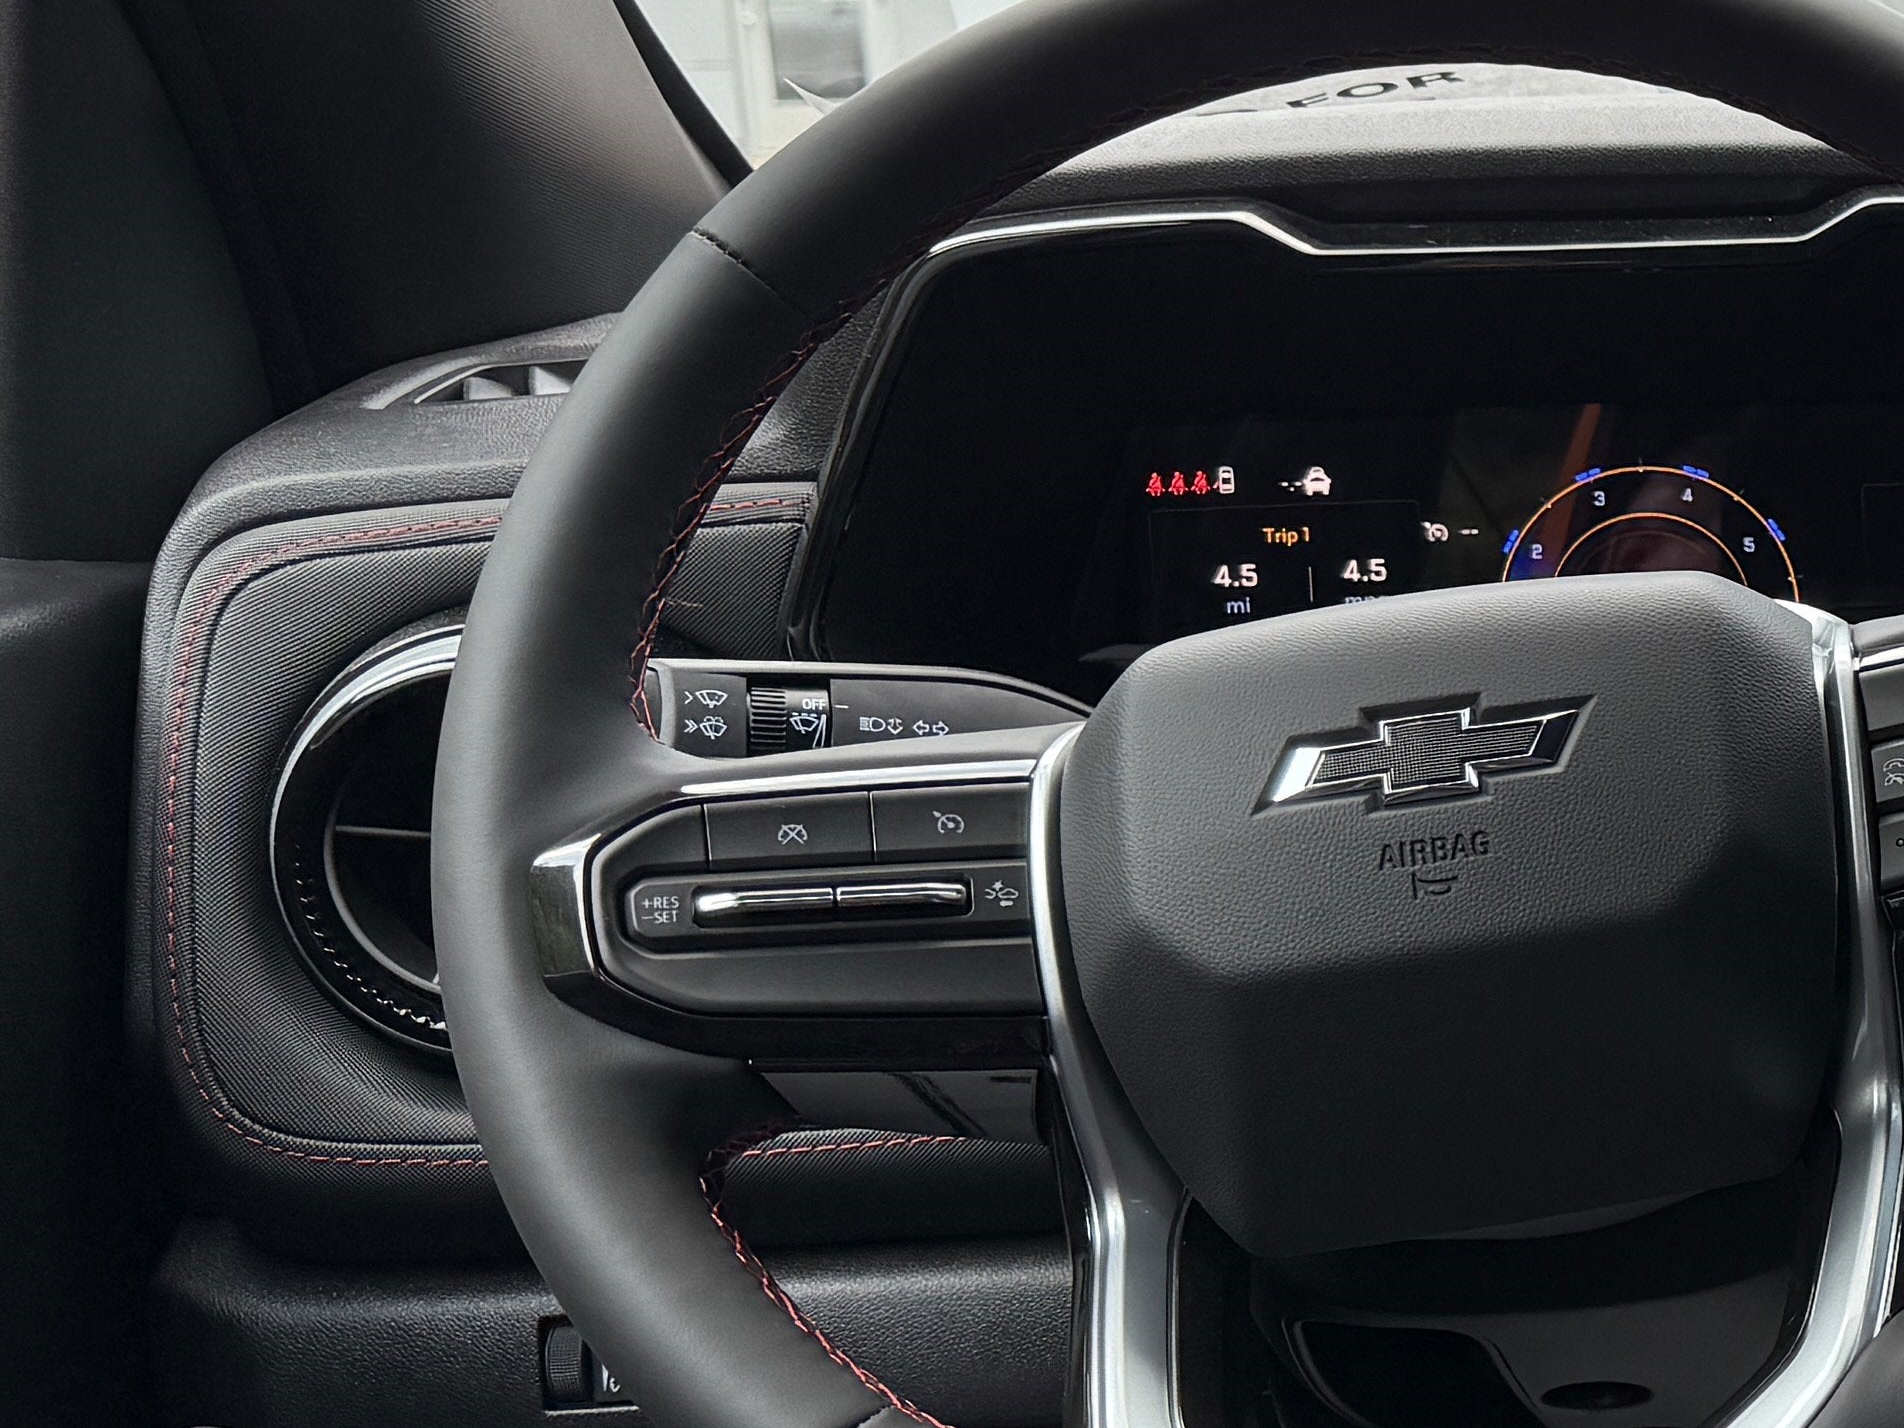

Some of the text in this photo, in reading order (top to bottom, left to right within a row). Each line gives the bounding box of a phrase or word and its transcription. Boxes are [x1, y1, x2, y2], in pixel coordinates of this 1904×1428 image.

[1592, 490, 1605, 506] 3
[1682, 487, 1693, 503] 4
[1262, 527, 1310, 547] Trip 1
[1742, 536, 1756, 553] 5
[1531, 543, 1543, 559] 2
[1212, 563, 1258, 589] 4.5
[1342, 558, 1388, 583] 4.5
[1226, 597, 1251, 615] mi
[802, 698, 826, 711] OFF
[1378, 831, 1490, 871] AIRBAG
